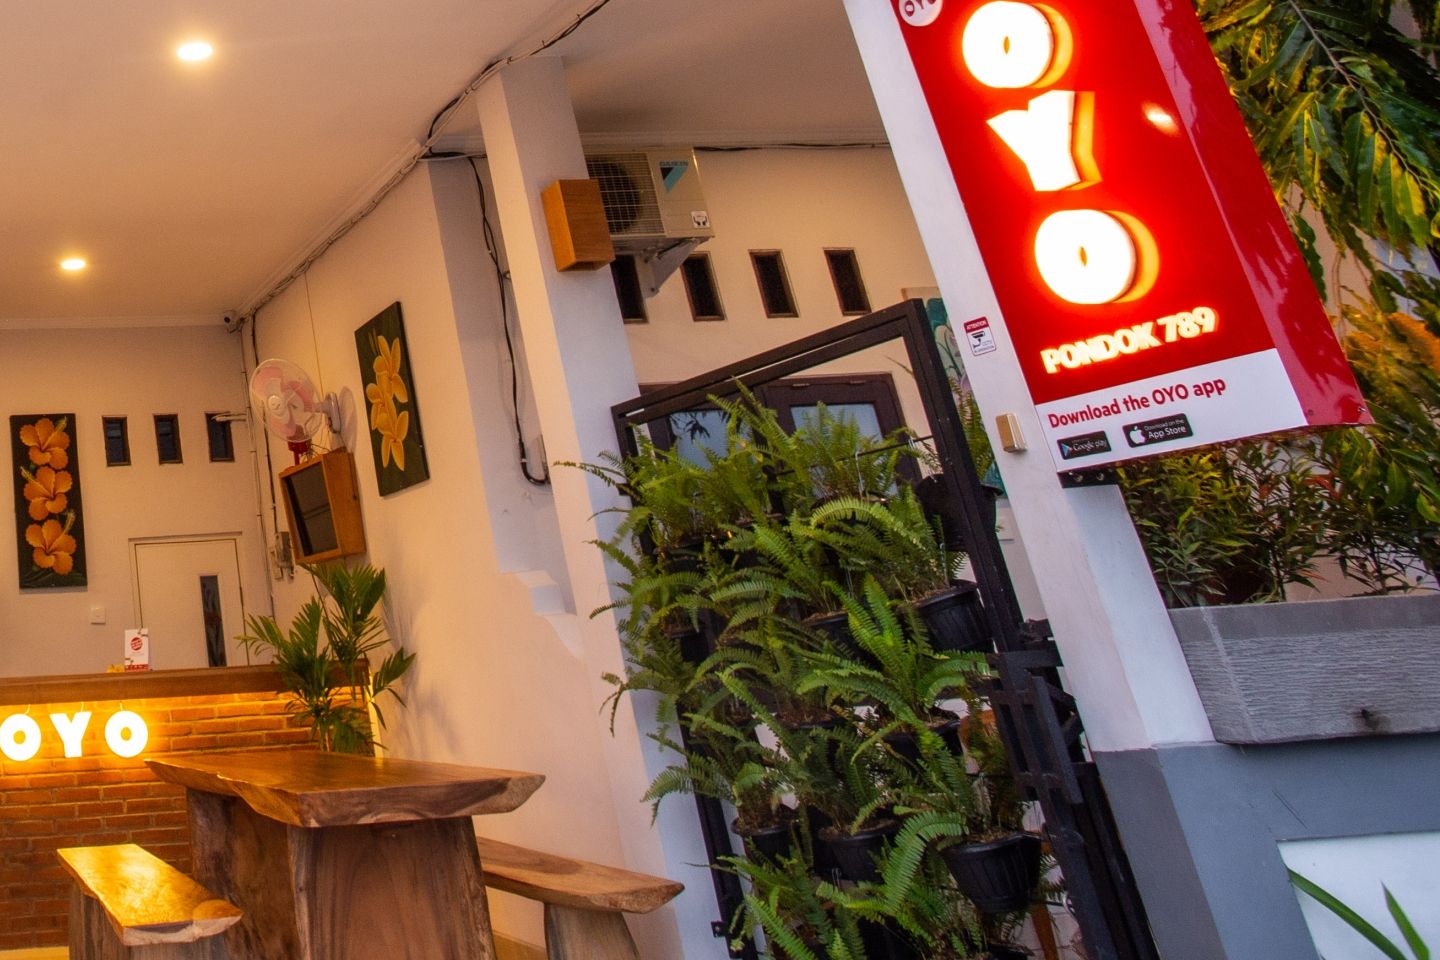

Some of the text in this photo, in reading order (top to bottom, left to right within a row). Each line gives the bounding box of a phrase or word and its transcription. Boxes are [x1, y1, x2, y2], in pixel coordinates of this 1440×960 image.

[962, 0, 1160, 305] OYO
[1040, 306, 1218, 375] PONDOK 789
[1048, 378, 1226, 428] Download the OYO app
[1072, 441, 1095, 452] Google
[1148, 426, 1186, 439] App Store
